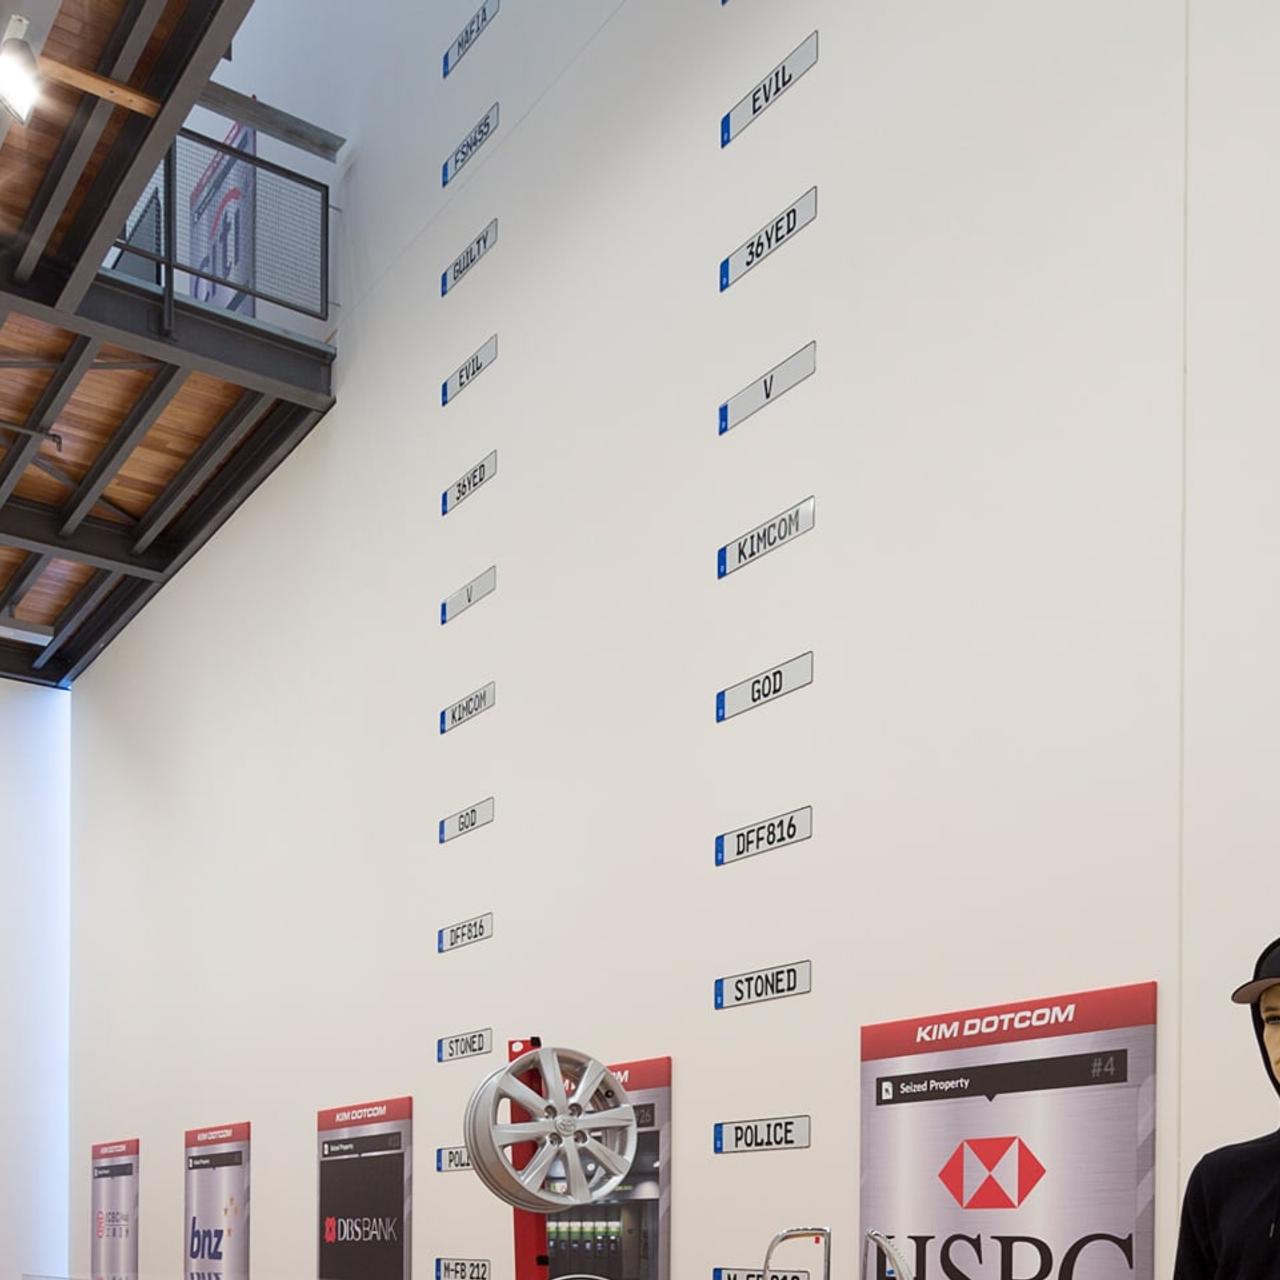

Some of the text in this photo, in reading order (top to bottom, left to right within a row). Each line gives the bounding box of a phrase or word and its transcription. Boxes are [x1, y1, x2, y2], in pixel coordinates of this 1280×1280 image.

[457, 7, 487, 56] MAFIA
[751, 64, 792, 115] EVIL
[745, 208, 797, 267] 36YED
[453, 230, 489, 281] GUILTY
[459, 355, 482, 387] EVIL
[763, 374, 773, 399] V
[456, 463, 485, 501] 36YED
[737, 508, 800, 564] KIMCOM
[466, 585, 473, 603] V
[751, 670, 783, 702] GOD
[451, 690, 487, 724] KIMCOM
[458, 809, 477, 832] GOD
[736, 815, 797, 856] DFF816
[449, 919, 484, 946] DFF816
[734, 968, 797, 1002] STONED
[916, 1004, 1076, 1043] KIM DOTCOM
[448, 1033, 484, 1057] STONED
[1091, 1055, 1115, 1078] #4
[899, 1077, 970, 1095] Seized Property
[335, 1105, 387, 1122] KIM DOTCOM
[734, 1121, 795, 1148] POLICE
[190, 1216, 224, 1260] bnz
[443, 1263, 487, 1280] M-FB 212
